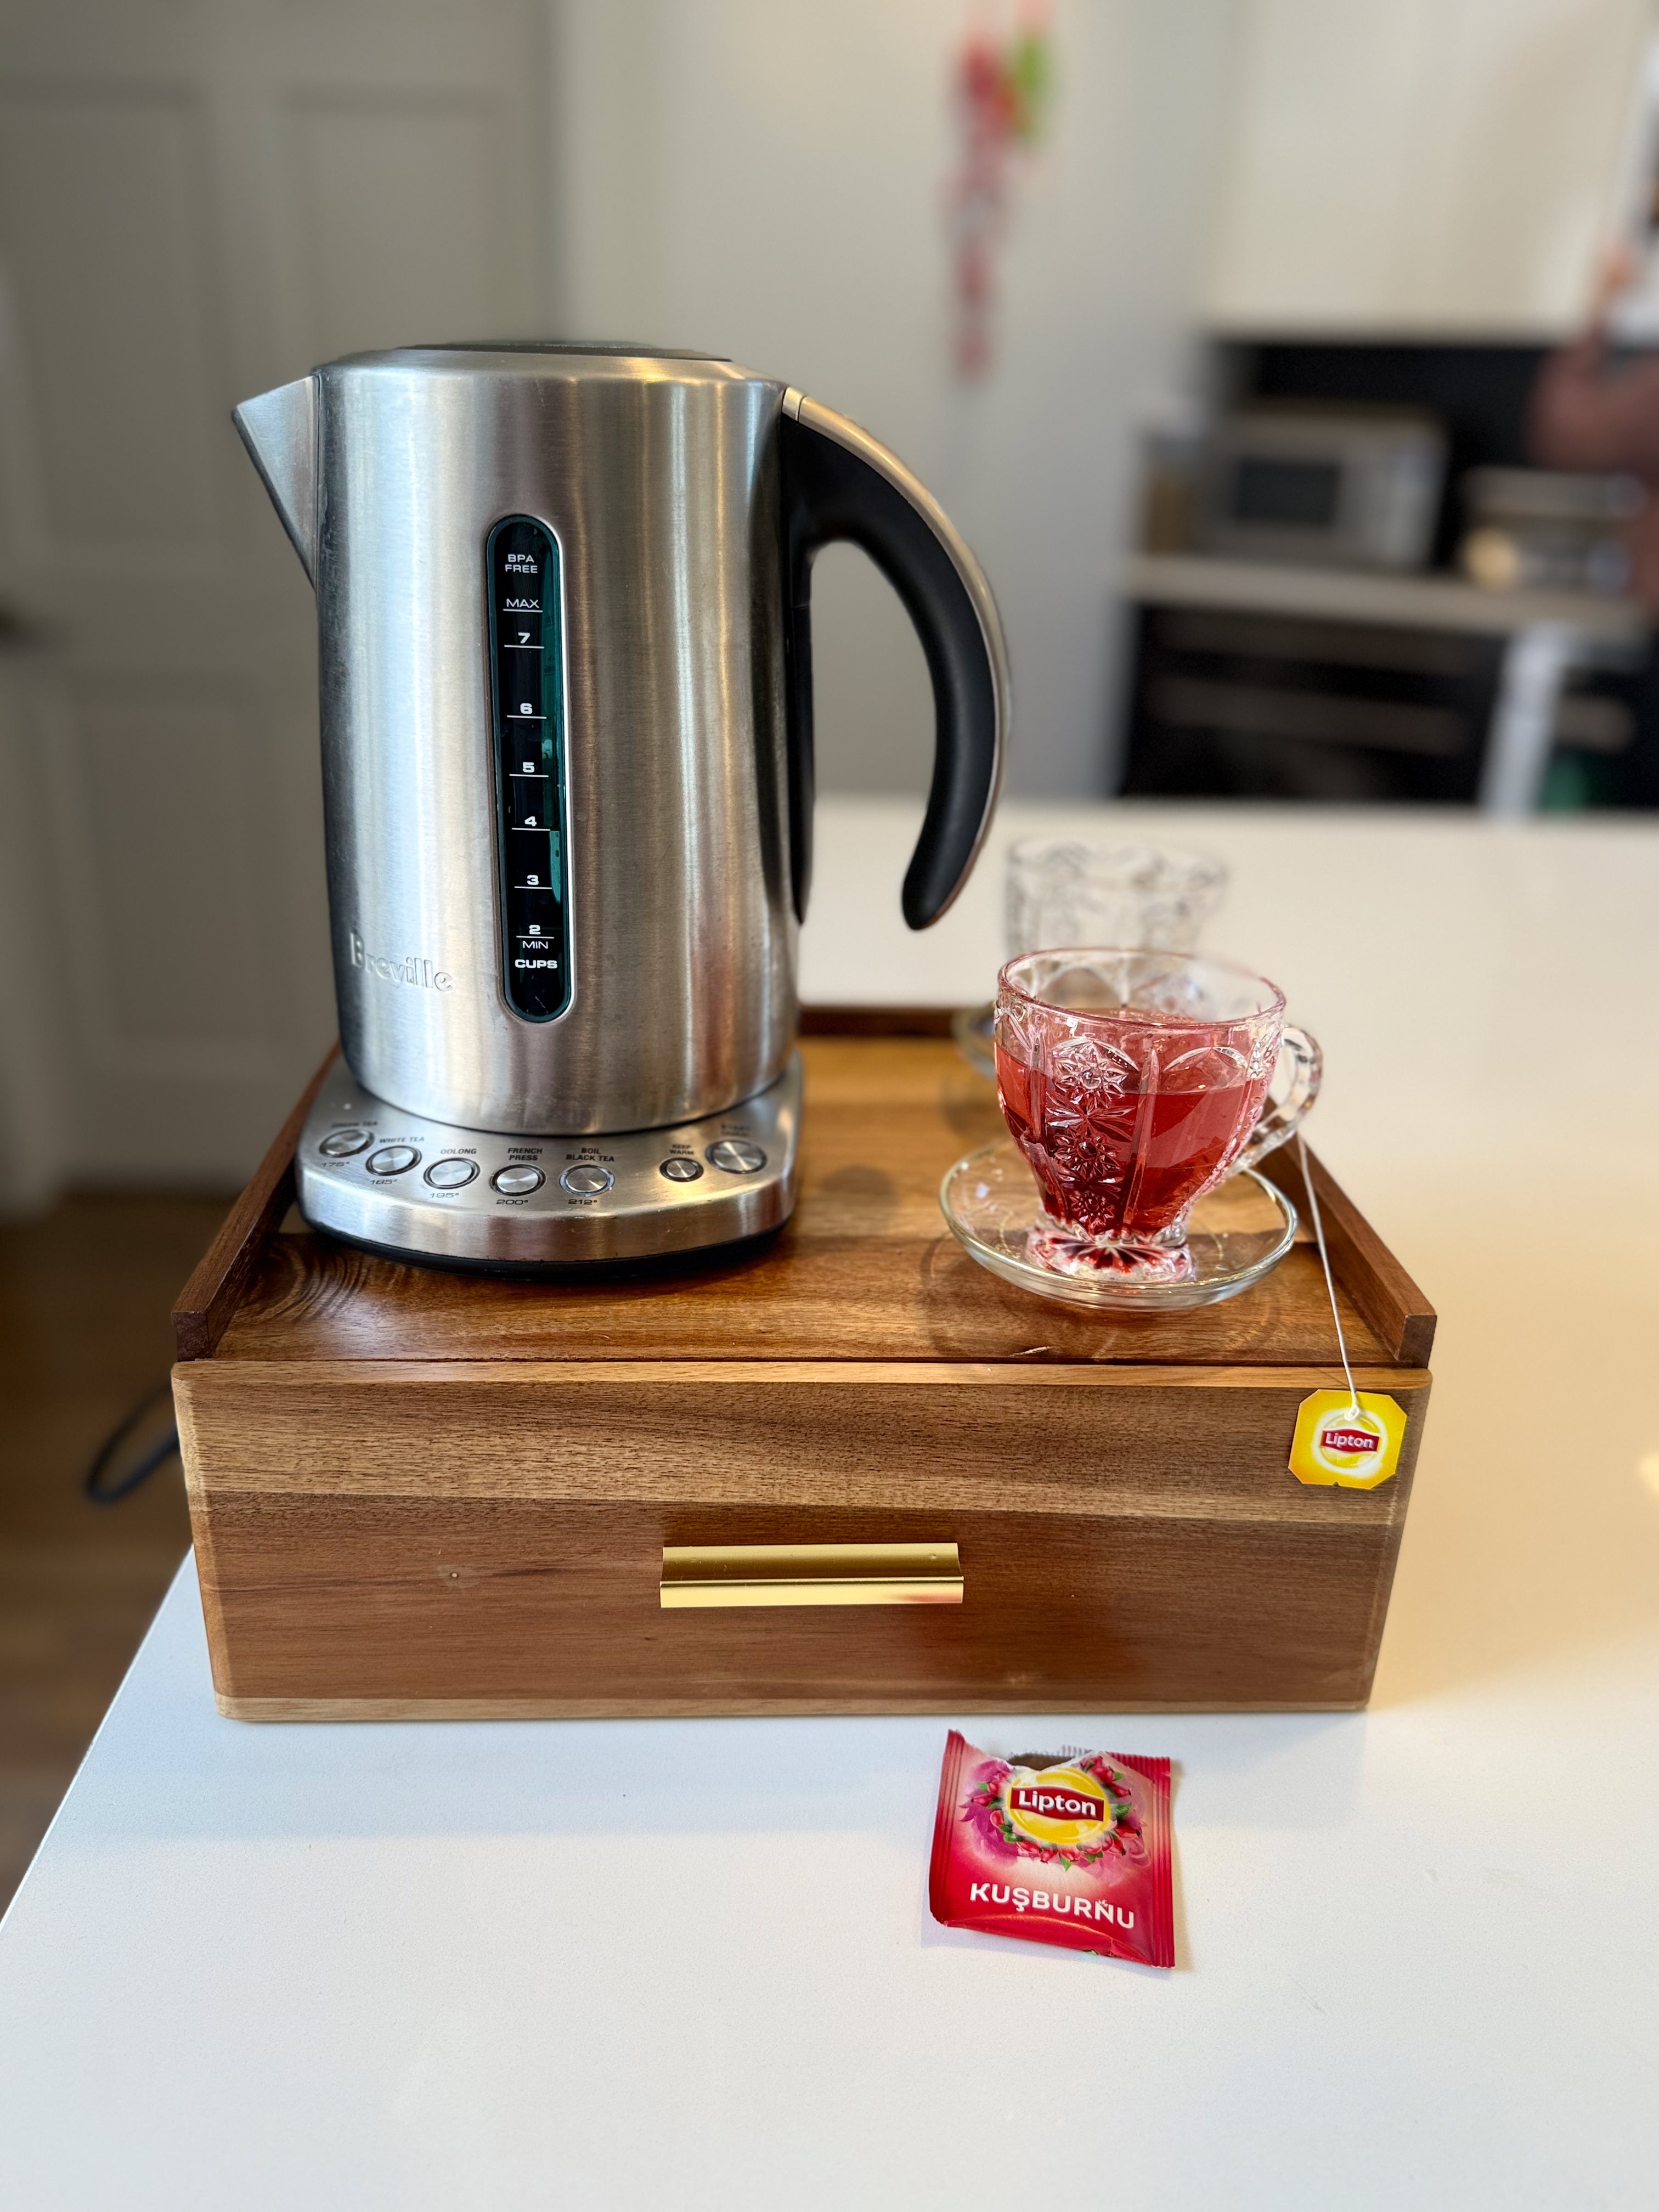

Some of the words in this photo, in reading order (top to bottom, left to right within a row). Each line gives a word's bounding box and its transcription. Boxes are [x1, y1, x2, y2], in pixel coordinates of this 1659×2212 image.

[507, 554, 534, 563] BPA
[505, 565, 538, 574] FREE
[506, 598, 540, 608] MAX
[518, 632, 531, 644] 7
[520, 703, 533, 715] 6
[522, 761, 535, 773] 5
[524, 816, 537, 827] 4
[527, 874, 539, 885] 3
[528, 924, 541, 935] 2
[522, 940, 549, 950] MIN
[349, 930, 453, 992] Breville
[515, 958, 558, 969] CUPS
[1325, 1432, 1374, 1448] Lipton
[1018, 1790, 1096, 1818] Lipton
